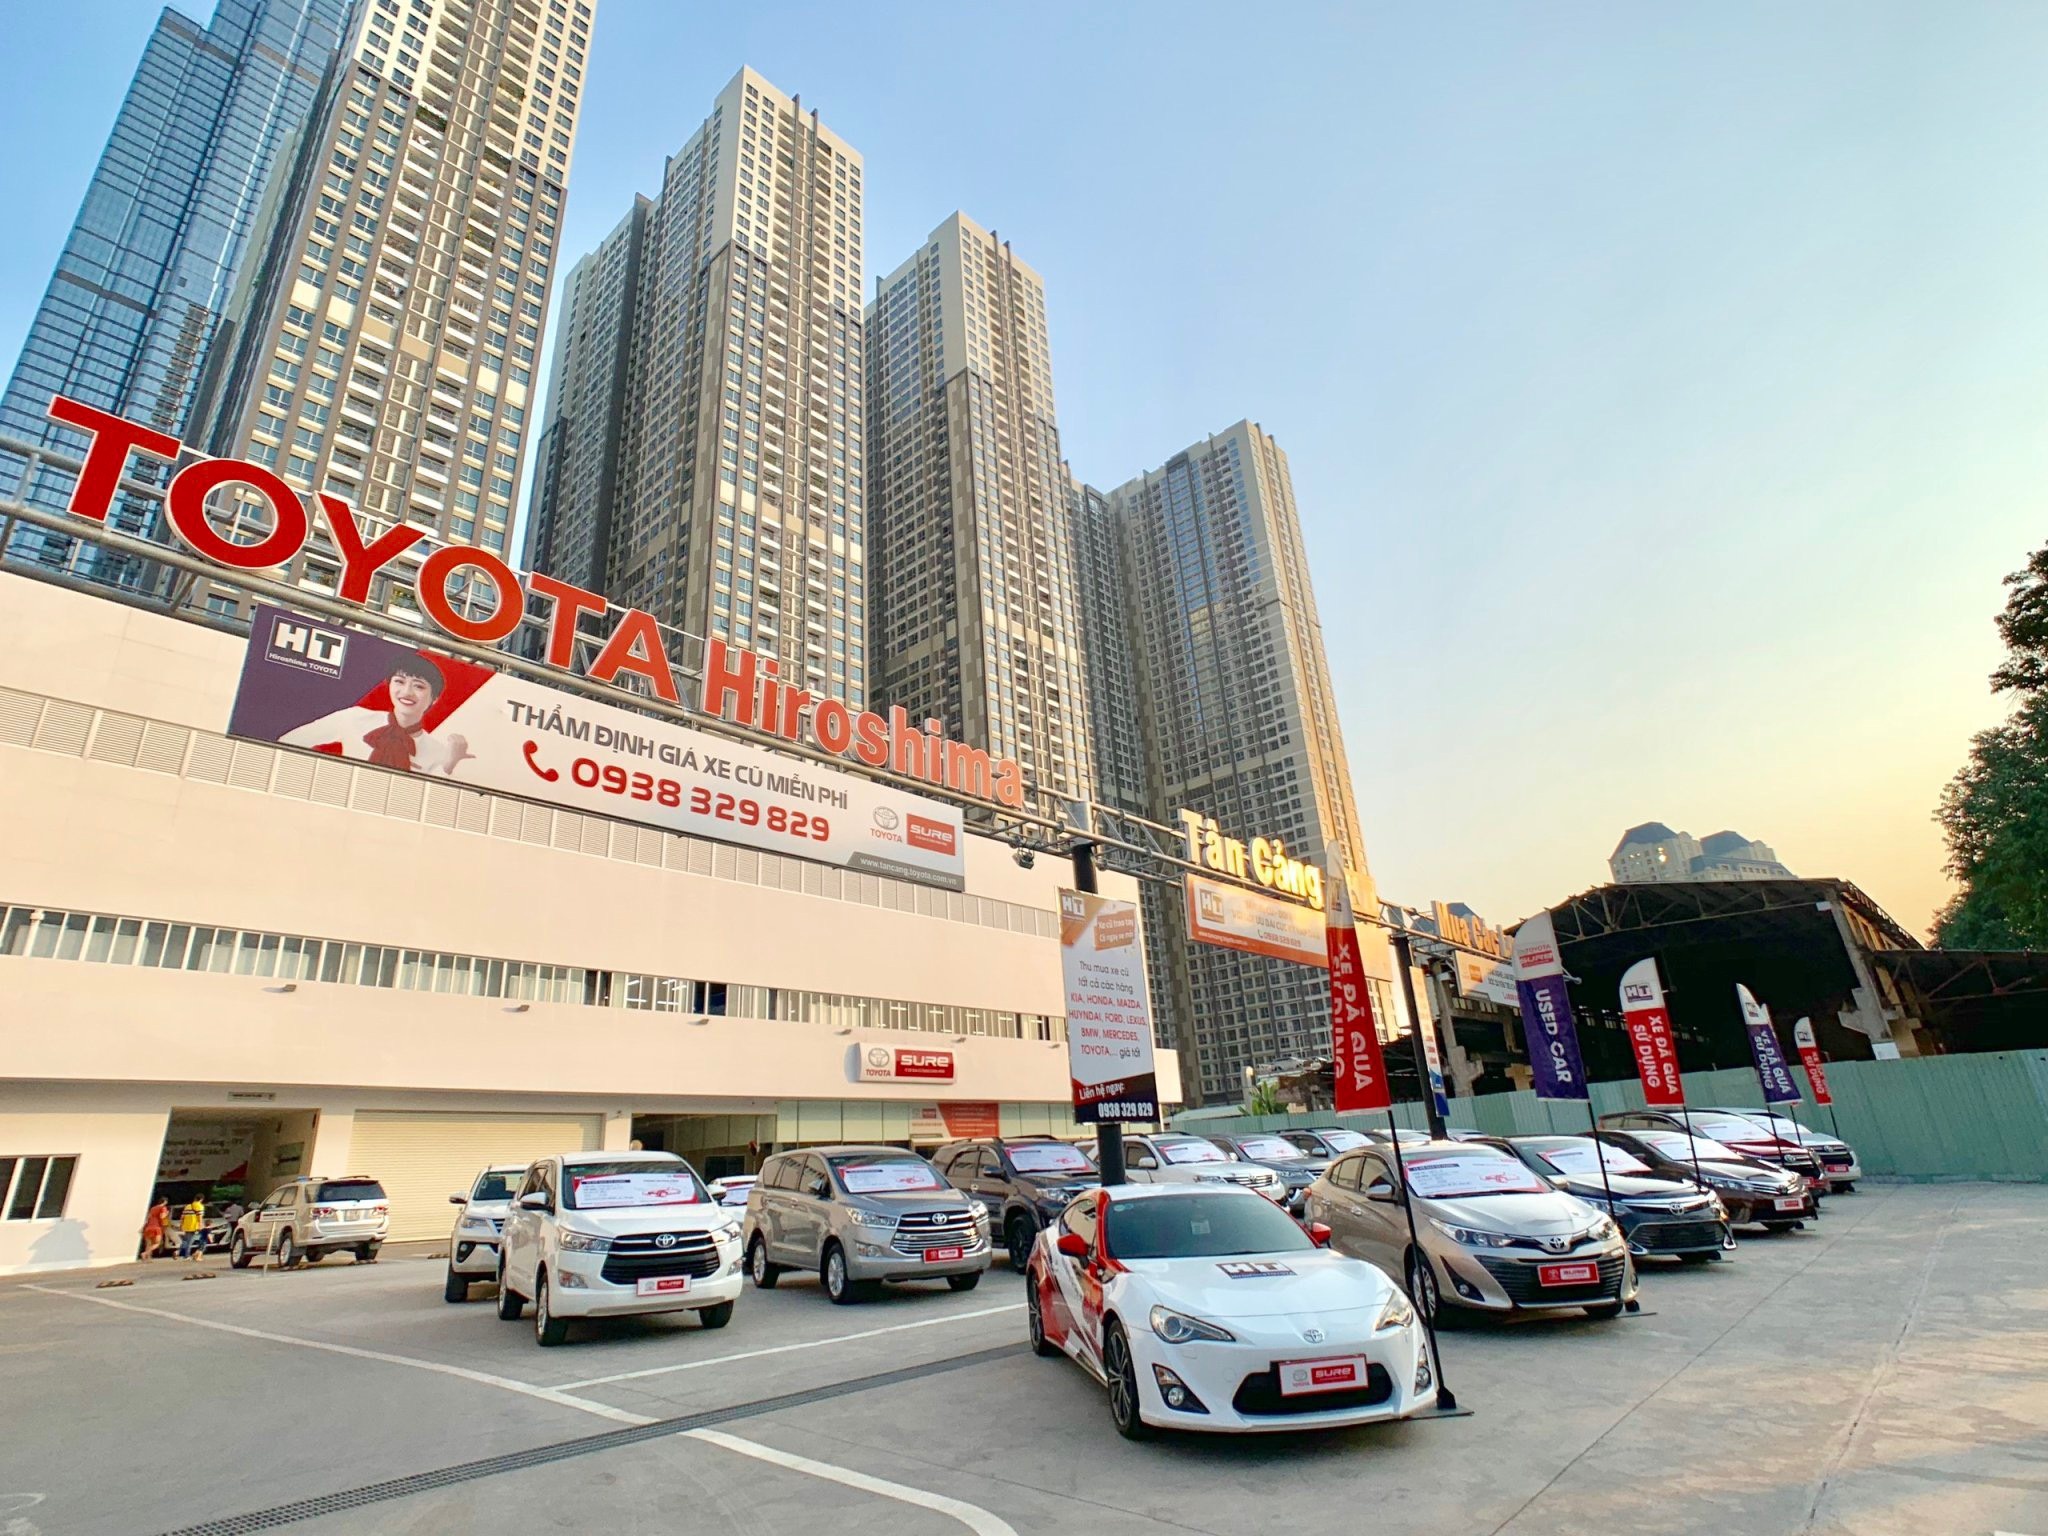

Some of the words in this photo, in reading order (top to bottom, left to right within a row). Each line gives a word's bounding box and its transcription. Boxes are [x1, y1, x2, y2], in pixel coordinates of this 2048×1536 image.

[47, 395, 680, 705] TOYOTA
[702, 637, 1025, 809] Hiroshima
[274, 622, 346, 667] HT
[268, 652, 308, 668] Hiroshima
[308, 662, 339, 676] TOYOTA
[507, 700, 590, 742] THẨM
[594, 724, 654, 760] ĐỊNH
[658, 743, 698, 771] GIÁ
[703, 755, 731, 779] XE
[735, 765, 763, 787] CŨ
[767, 772, 814, 802] MIỄN
[818, 786, 848, 810] PHÍ
[571, 757, 682, 808] 0938
[690, 786, 760, 826] 329
[767, 805, 830, 842] 829
[870, 828, 903, 843] TOYOTA
[860, 857, 957, 885] www.tancang.toyota.com.vn
[1178, 808, 1246, 878] Tân
[1250, 836, 1325, 910] Cảng
[1625, 986, 1652, 998] HT
[1338, 943, 1353, 975] XE
[1351, 1031, 1374, 1092] QUA
[1648, 1015, 1665, 1033] XE
[1535, 988, 1558, 1036] USED
[1550, 1041, 1573, 1083] CAR
[1633, 1024, 1650, 1042] SỬ
[1655, 1037, 1672, 1058] ĐÃ
[865, 1068, 891, 1077] TOYOTA
[1638, 1045, 1660, 1088] DỤNG
[1663, 1063, 1678, 1095] QUA
[1079, 1086, 1095, 1099] Liên
[1095, 1084, 1106, 1098] hệ
[1772, 1067, 1792, 1094] QUA
[1098, 1102, 1120, 1117] 0938
[1121, 1102, 1136, 1117] 329
[1138, 1102, 1153, 1117] 829
